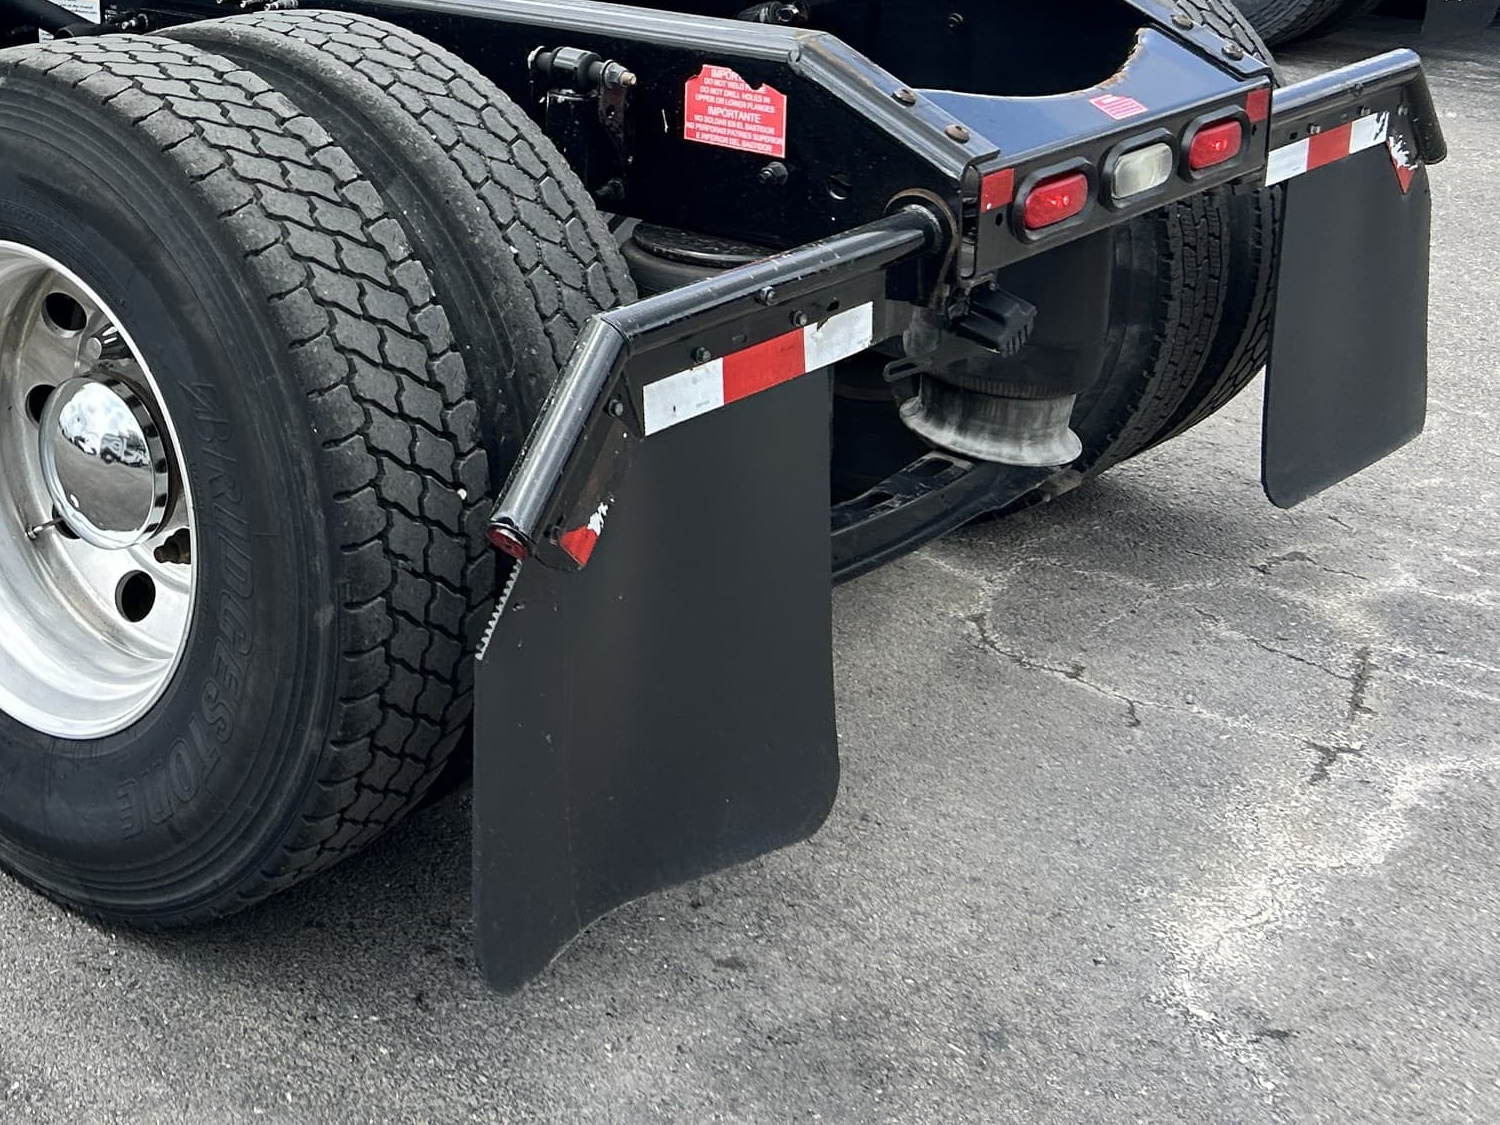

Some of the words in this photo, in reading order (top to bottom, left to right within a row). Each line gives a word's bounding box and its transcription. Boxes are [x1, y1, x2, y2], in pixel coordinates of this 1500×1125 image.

[704, 77, 713, 85] DO
[713, 78, 725, 87] NOT
[695, 93, 715, 103] UPPER
[725, 99, 746, 108] LOWER
[747, 102, 776, 113] FLANGES
[709, 87, 723, 96] NOT
[724, 90, 740, 99] DRILL
[742, 92, 762, 102] HOLES
[707, 106, 761, 123] IMPORTANTE
[117, 379, 256, 842] BRIDGESTONE
